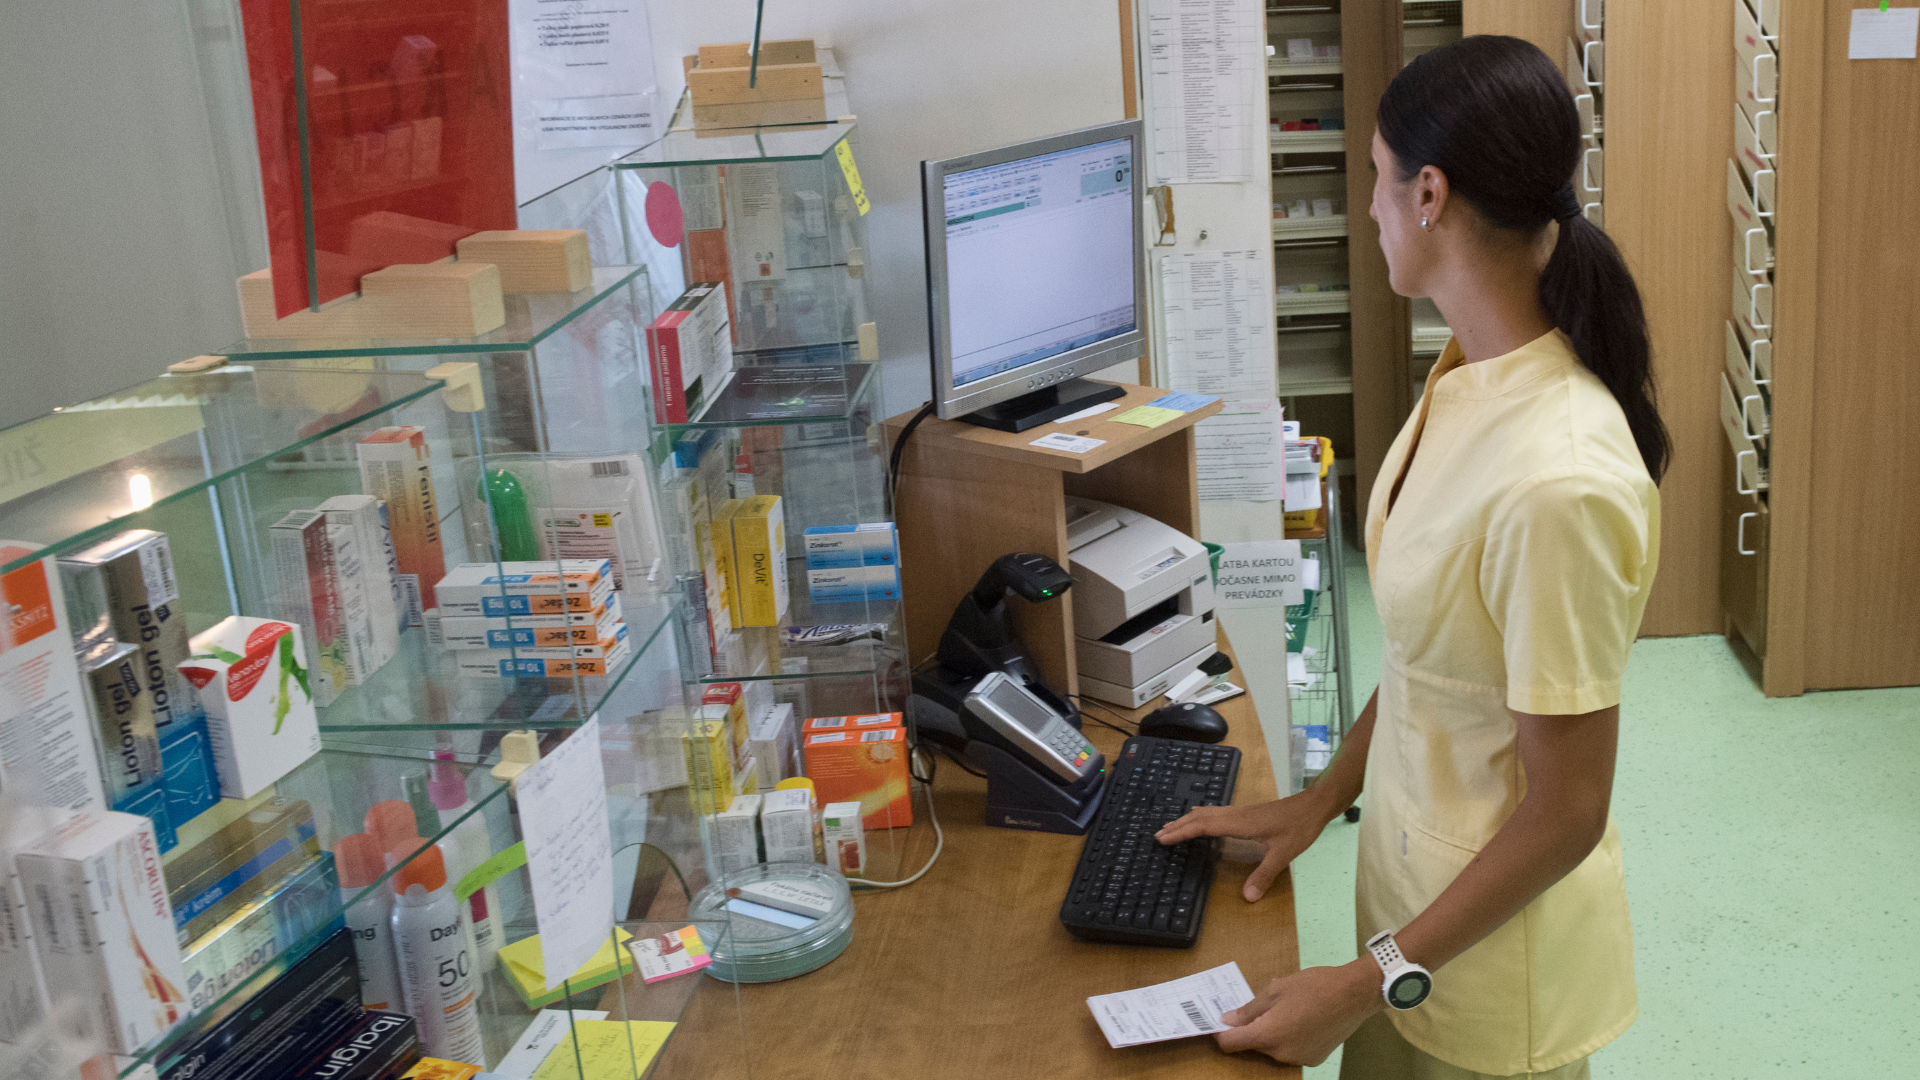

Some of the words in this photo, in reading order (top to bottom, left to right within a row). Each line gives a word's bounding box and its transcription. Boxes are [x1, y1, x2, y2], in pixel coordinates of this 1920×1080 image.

[418, 464, 439, 544] Fenistil
[752, 552, 768, 586] DeVit
[1251, 557, 1295, 568] KARTOU
[1263, 573, 1296, 584] MIMO
[509, 599, 524, 609] 10
[1225, 588, 1284, 600] PREVÁDZKY
[130, 604, 160, 642] gel
[514, 632, 529, 642] 10
[526, 663, 540, 673] 10
[107, 682, 132, 715] gel
[146, 650, 173, 728] Lioton
[119, 720, 142, 788] Lioton
[140, 831, 166, 920] ASCORUTIN
[219, 937, 276, 989] Lioton
[438, 950, 470, 988] 50
[314, 1015, 407, 1076] Ibalgin
